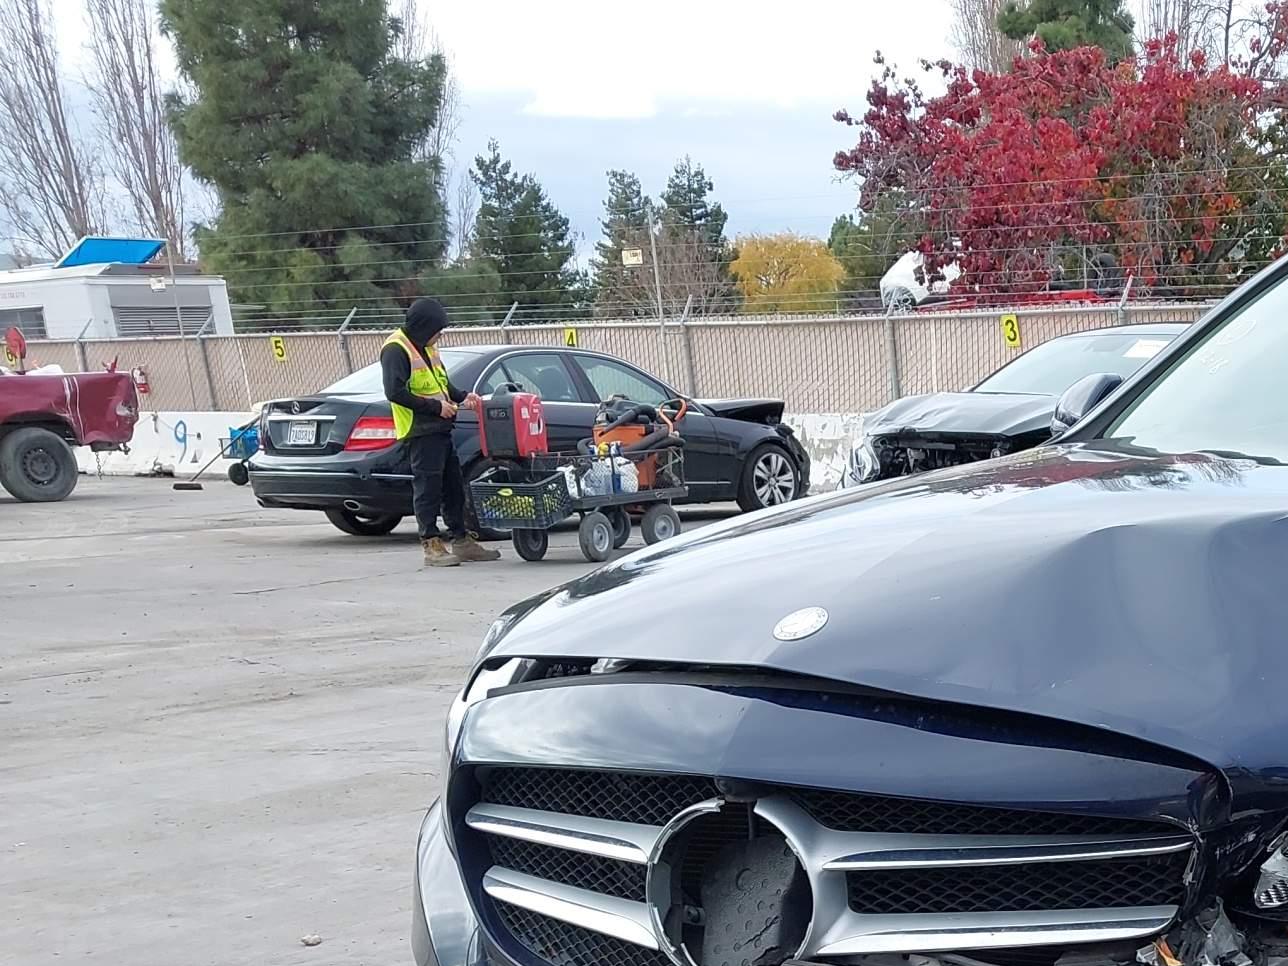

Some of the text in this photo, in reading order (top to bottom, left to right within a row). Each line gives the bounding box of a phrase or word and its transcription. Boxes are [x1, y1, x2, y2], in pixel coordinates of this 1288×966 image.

[566, 331, 577, 347] 4
[1004, 318, 1018, 342] 3
[273, 339, 285, 358] 5
